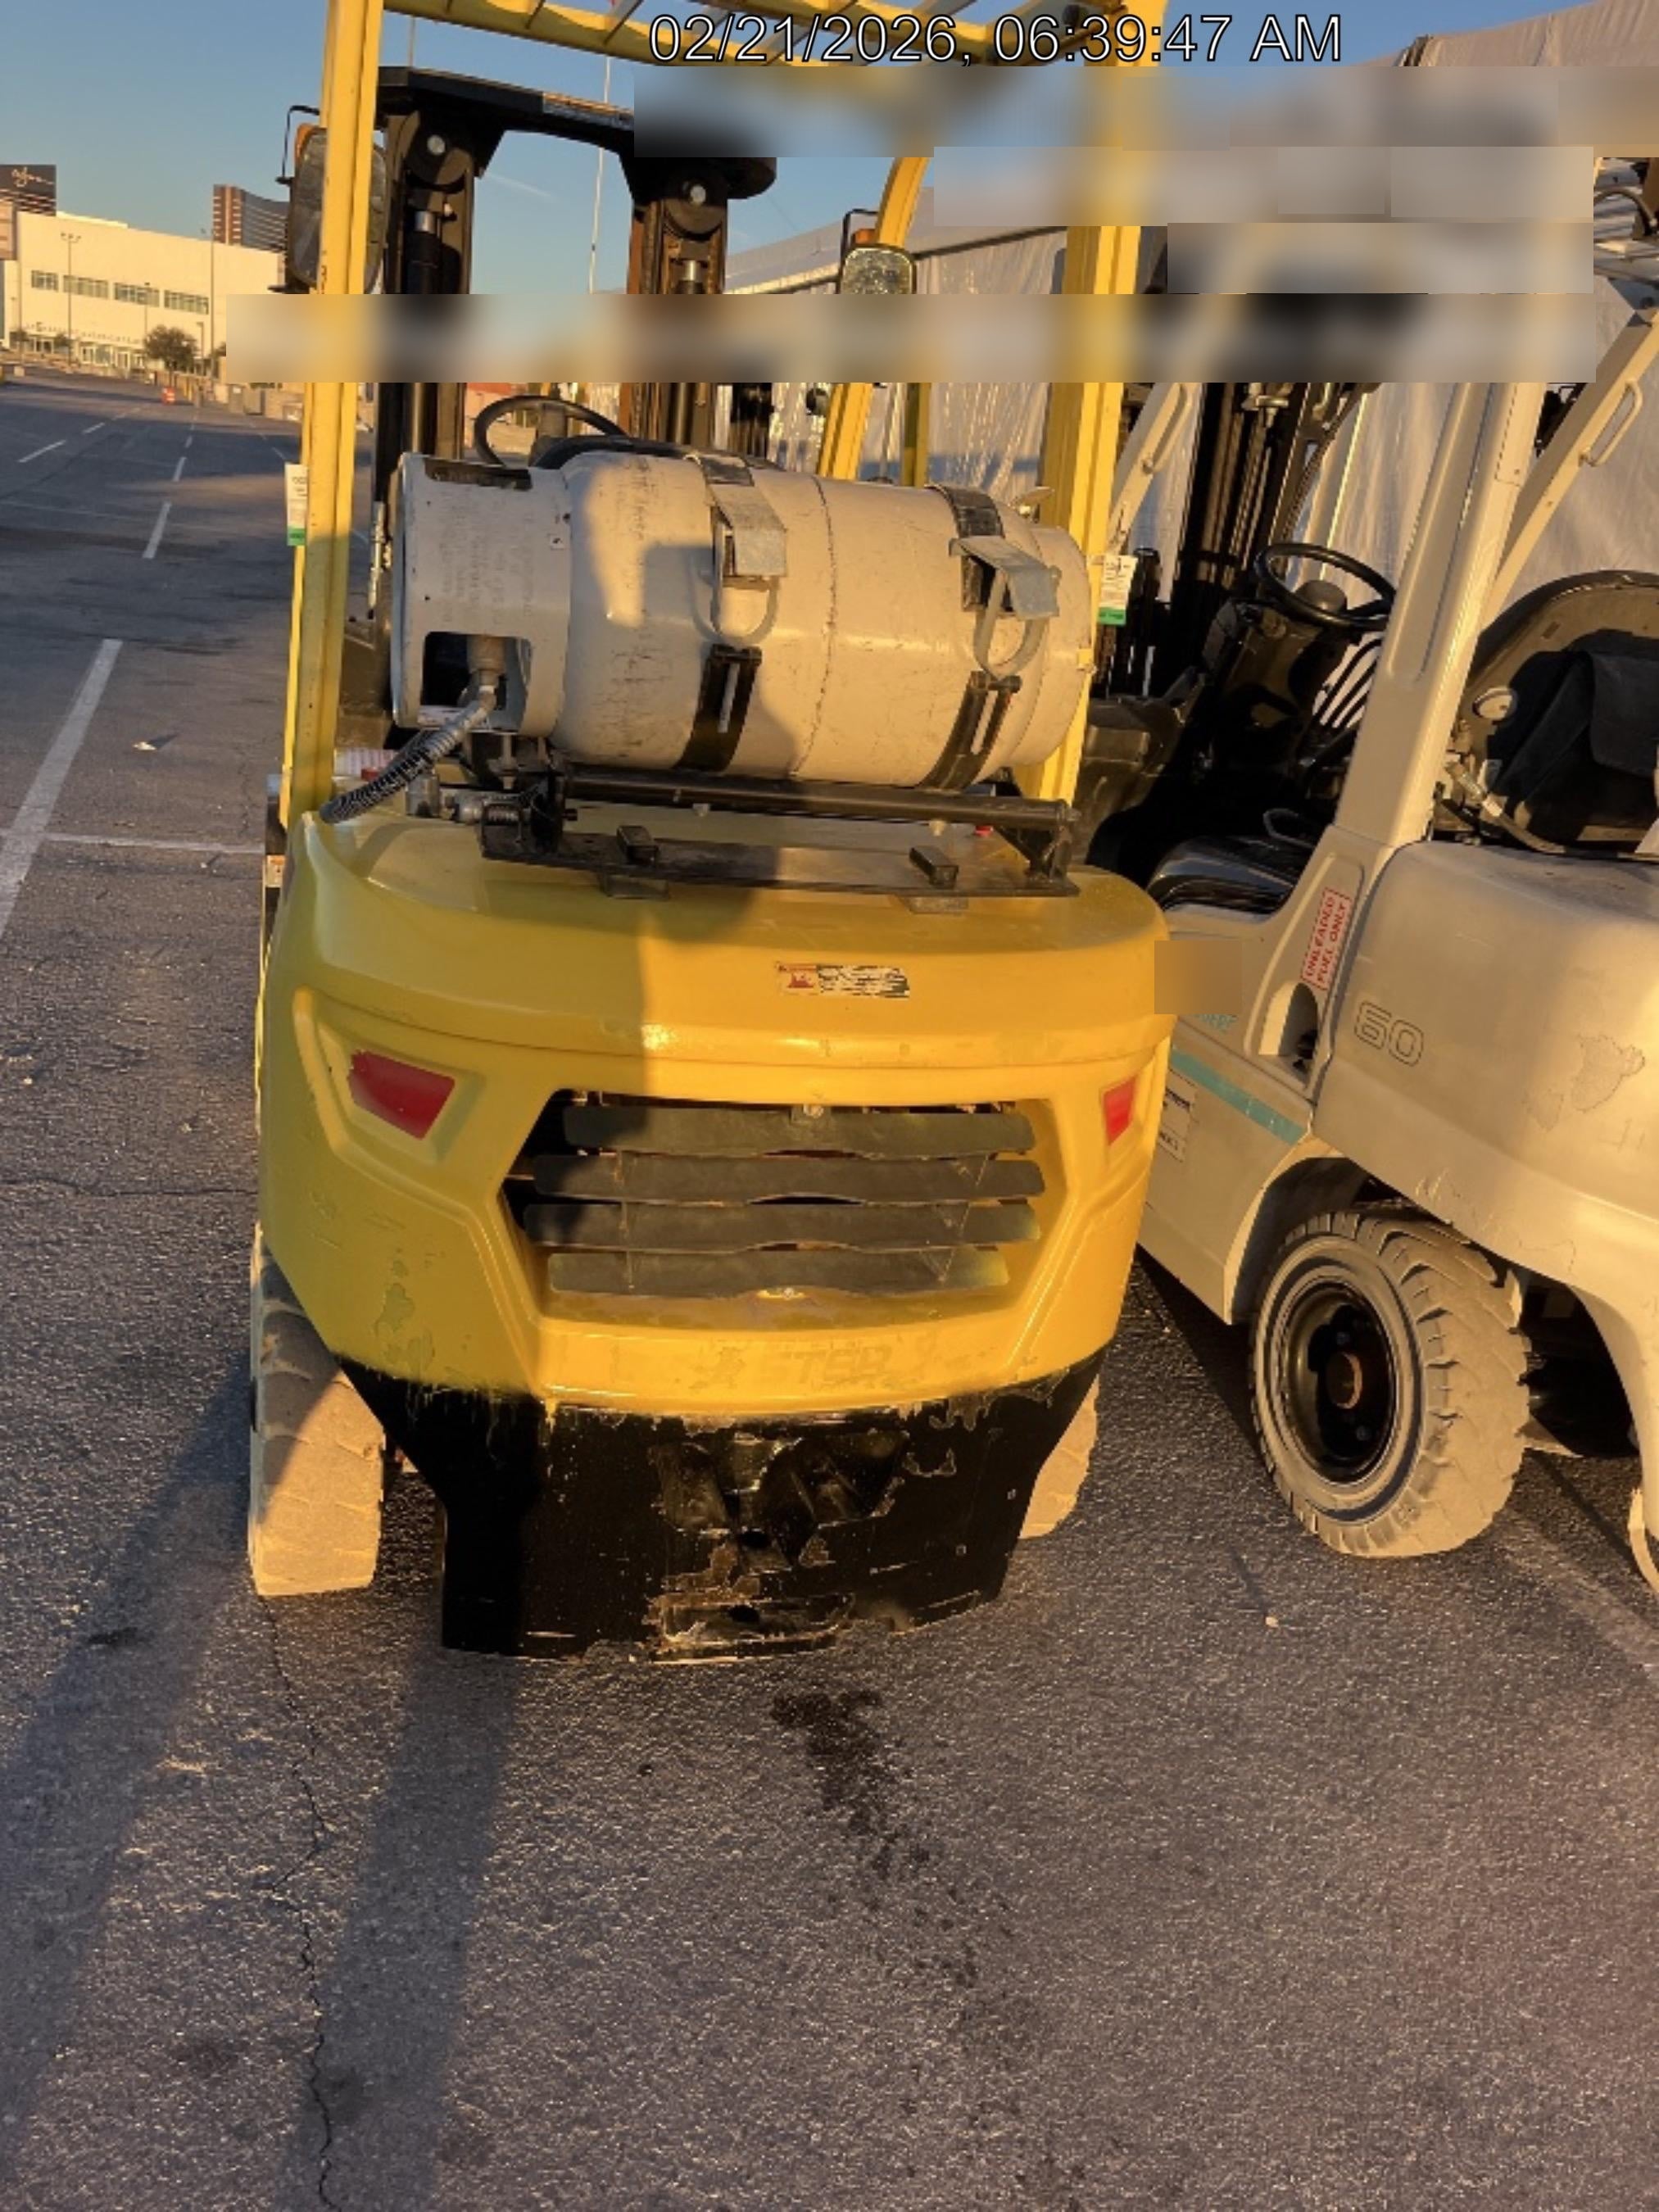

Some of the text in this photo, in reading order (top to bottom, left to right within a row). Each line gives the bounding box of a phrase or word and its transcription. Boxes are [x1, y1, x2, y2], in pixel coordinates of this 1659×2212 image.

[1306, 896, 1335, 977] UNLEADED
[1329, 902, 1346, 942] ONLY
[1354, 1000, 1424, 1067] 60
